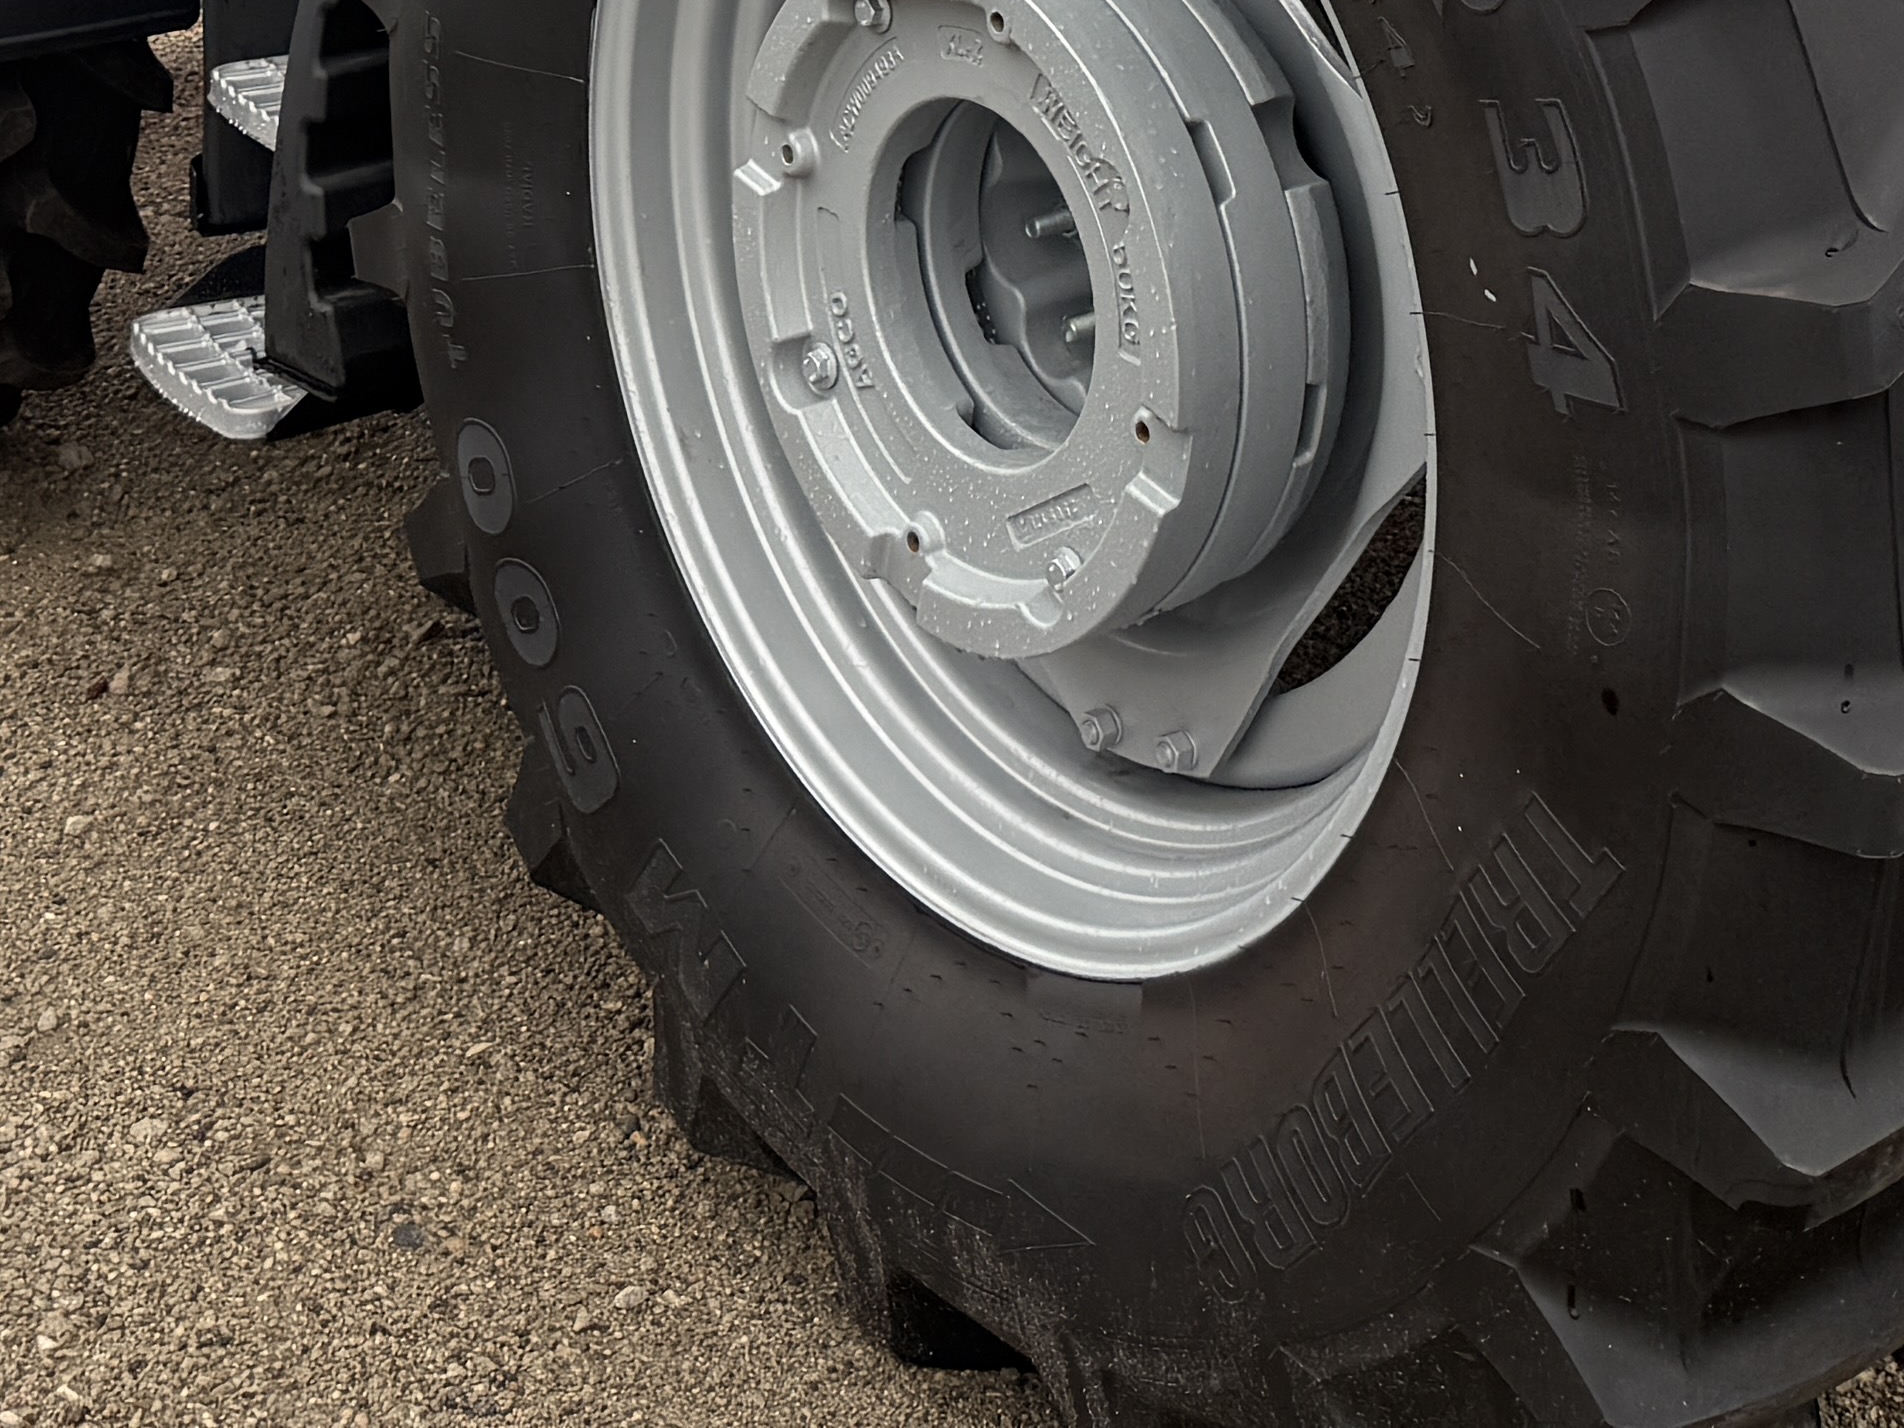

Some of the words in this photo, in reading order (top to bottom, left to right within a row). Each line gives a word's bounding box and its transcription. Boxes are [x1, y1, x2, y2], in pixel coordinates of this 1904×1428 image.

[826, 288, 874, 390] AGCO
[1477, 97, 1628, 418] 34
[457, 416, 619, 814] 600
[1182, 790, 1627, 1304] TRELLEBORG
